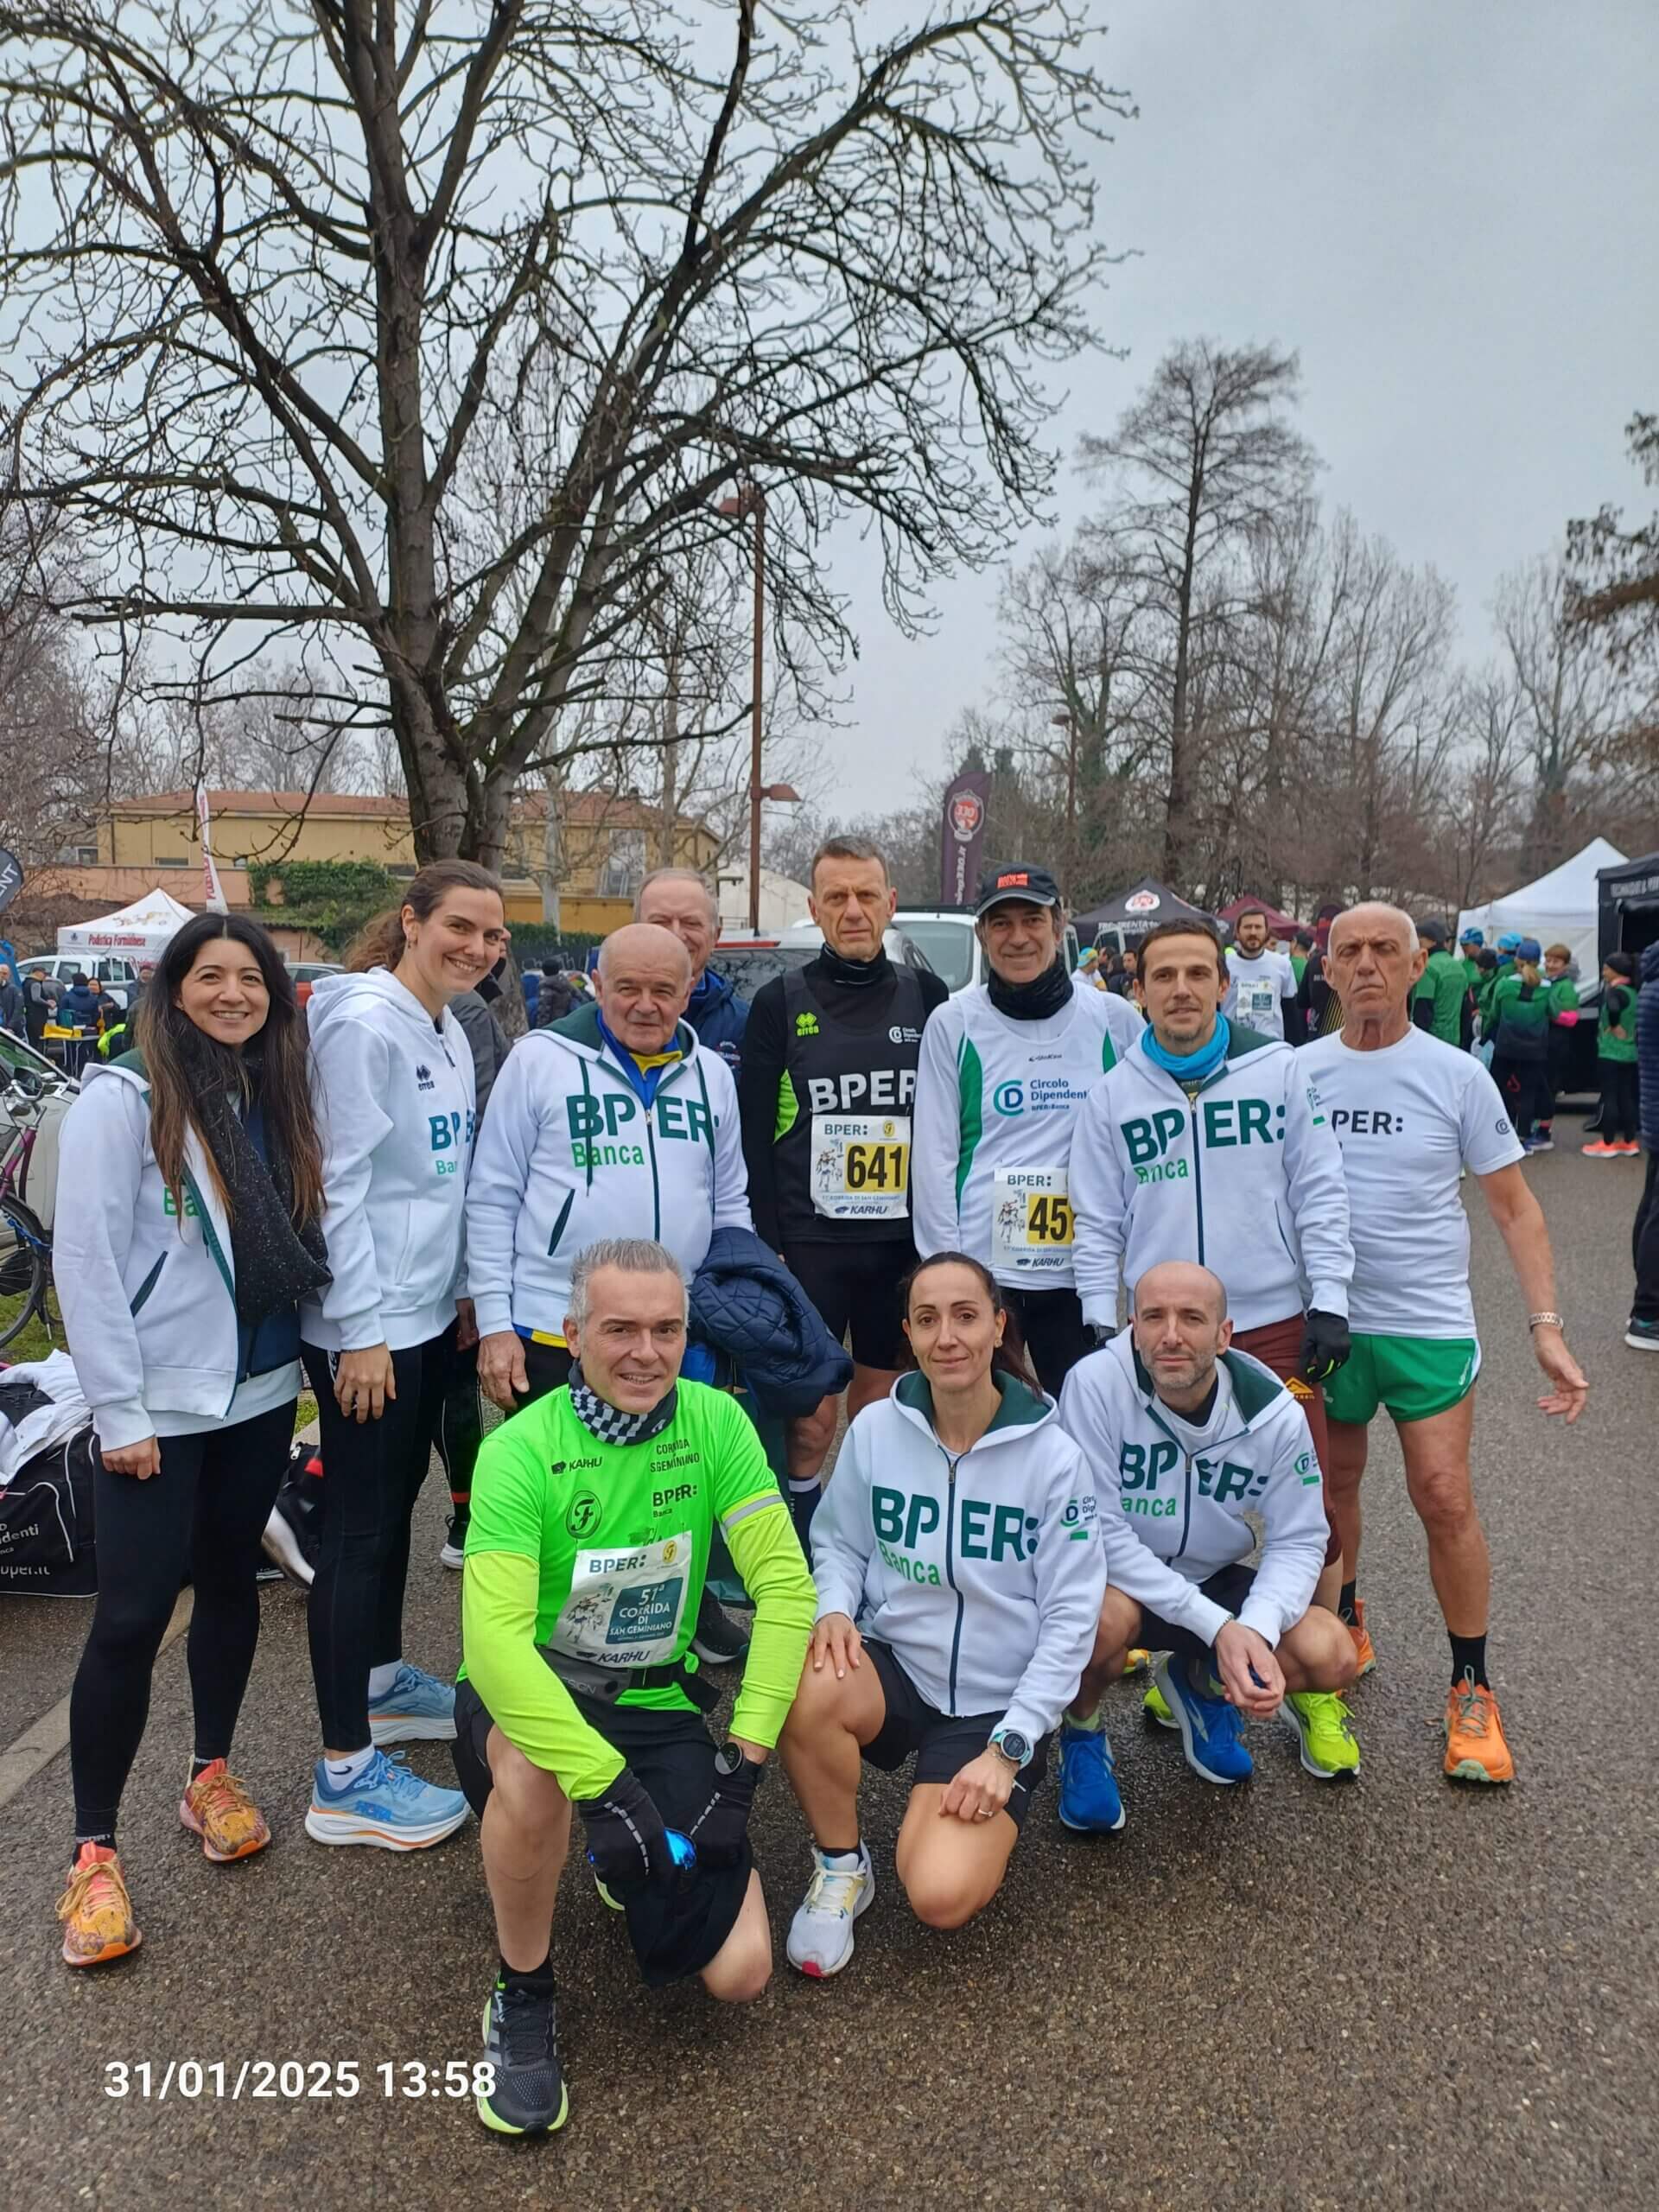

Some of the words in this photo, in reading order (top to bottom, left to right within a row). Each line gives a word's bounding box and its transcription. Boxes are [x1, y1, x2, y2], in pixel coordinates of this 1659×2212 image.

[1030, 1077, 1069, 1089] Circolo
[808, 1069, 918, 1114] BPER
[1031, 1090, 1090, 1102] Dipendent
[824, 1123, 868, 1135] BPER:
[1332, 1109, 1404, 1135] PER:
[571, 1141, 645, 1167] Banca
[847, 1145, 902, 1189] 641
[1007, 1174, 1052, 1187] BPER:
[850, 1205, 888, 1215] KARHU
[1029, 1197, 1075, 1242] 45
[1032, 1258, 1065, 1268] KARHU
[653, 1484, 697, 1507] BPER:
[1121, 1497, 1176, 1517] anca
[872, 1485, 1039, 1562] BPER:
[589, 1554, 647, 1573] BPER:
[878, 1540, 941, 1587] Banca
[626, 1621, 672, 1634] GEMINIANO
[638, 1615, 649, 1625] DI
[609, 1627, 626, 1636] SAN
[597, 1650, 650, 1663] KARHU
